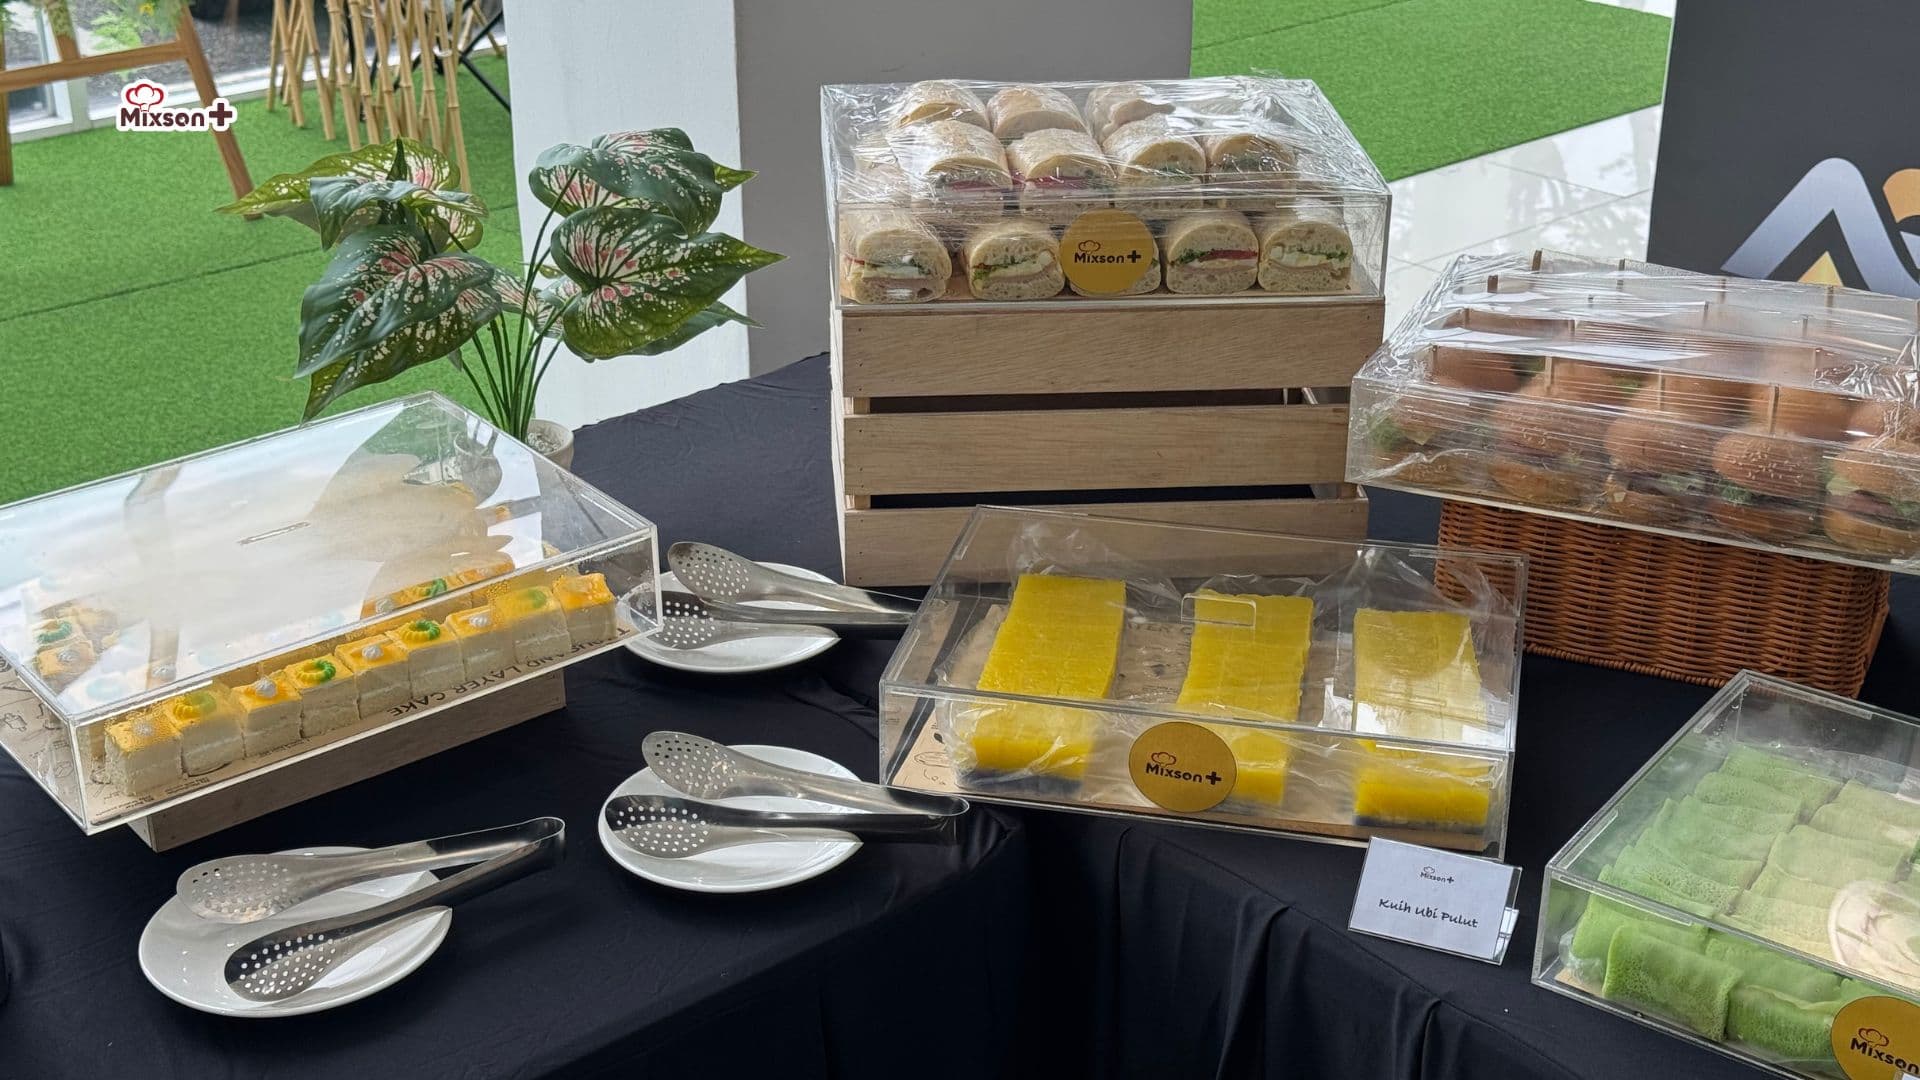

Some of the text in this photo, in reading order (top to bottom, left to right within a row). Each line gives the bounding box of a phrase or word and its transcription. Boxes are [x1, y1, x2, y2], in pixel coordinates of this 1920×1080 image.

[455, 665, 522, 695] LAYER
[386, 691, 446, 717] CAKE
[1378, 898, 1411, 914] Kuih
[1441, 911, 1479, 929] Pulut
